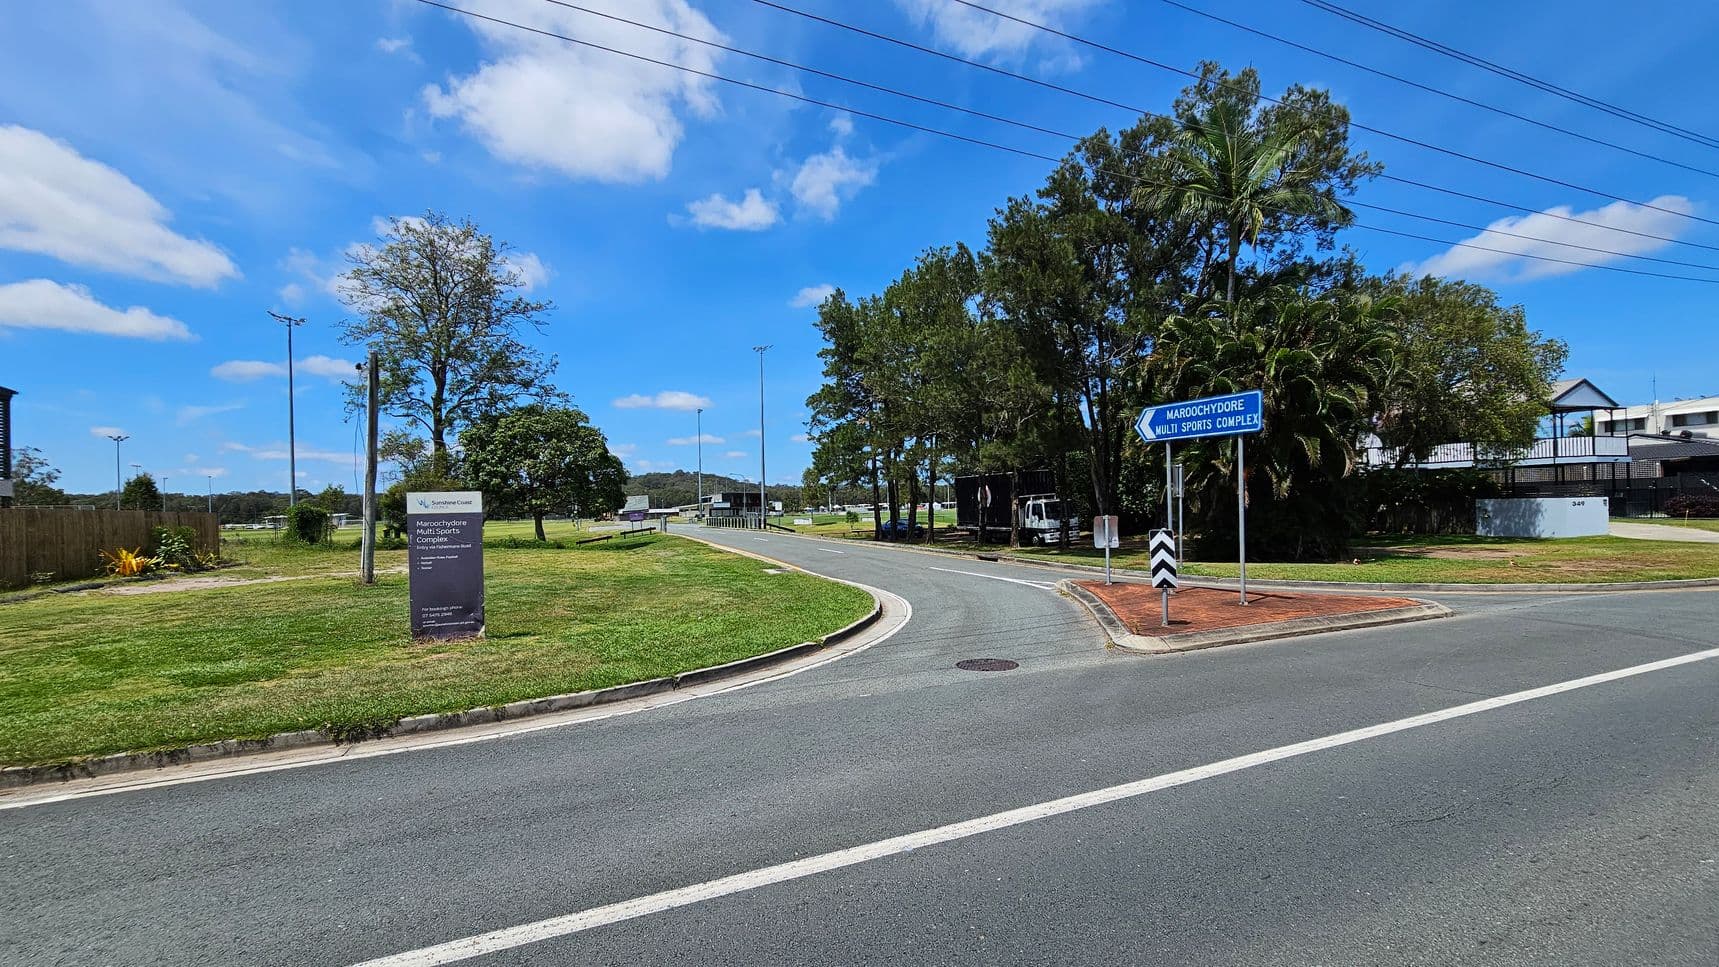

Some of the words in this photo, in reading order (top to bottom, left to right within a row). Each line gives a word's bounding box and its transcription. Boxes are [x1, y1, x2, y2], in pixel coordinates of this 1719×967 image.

[1166, 399, 1245, 420] MAROOCHYDORE
[1155, 423, 1178, 436] MULTI
[1181, 418, 1213, 432] SPORTS
[1216, 413, 1259, 428] COMPLEX
[416, 520, 467, 528] Maroochydore
